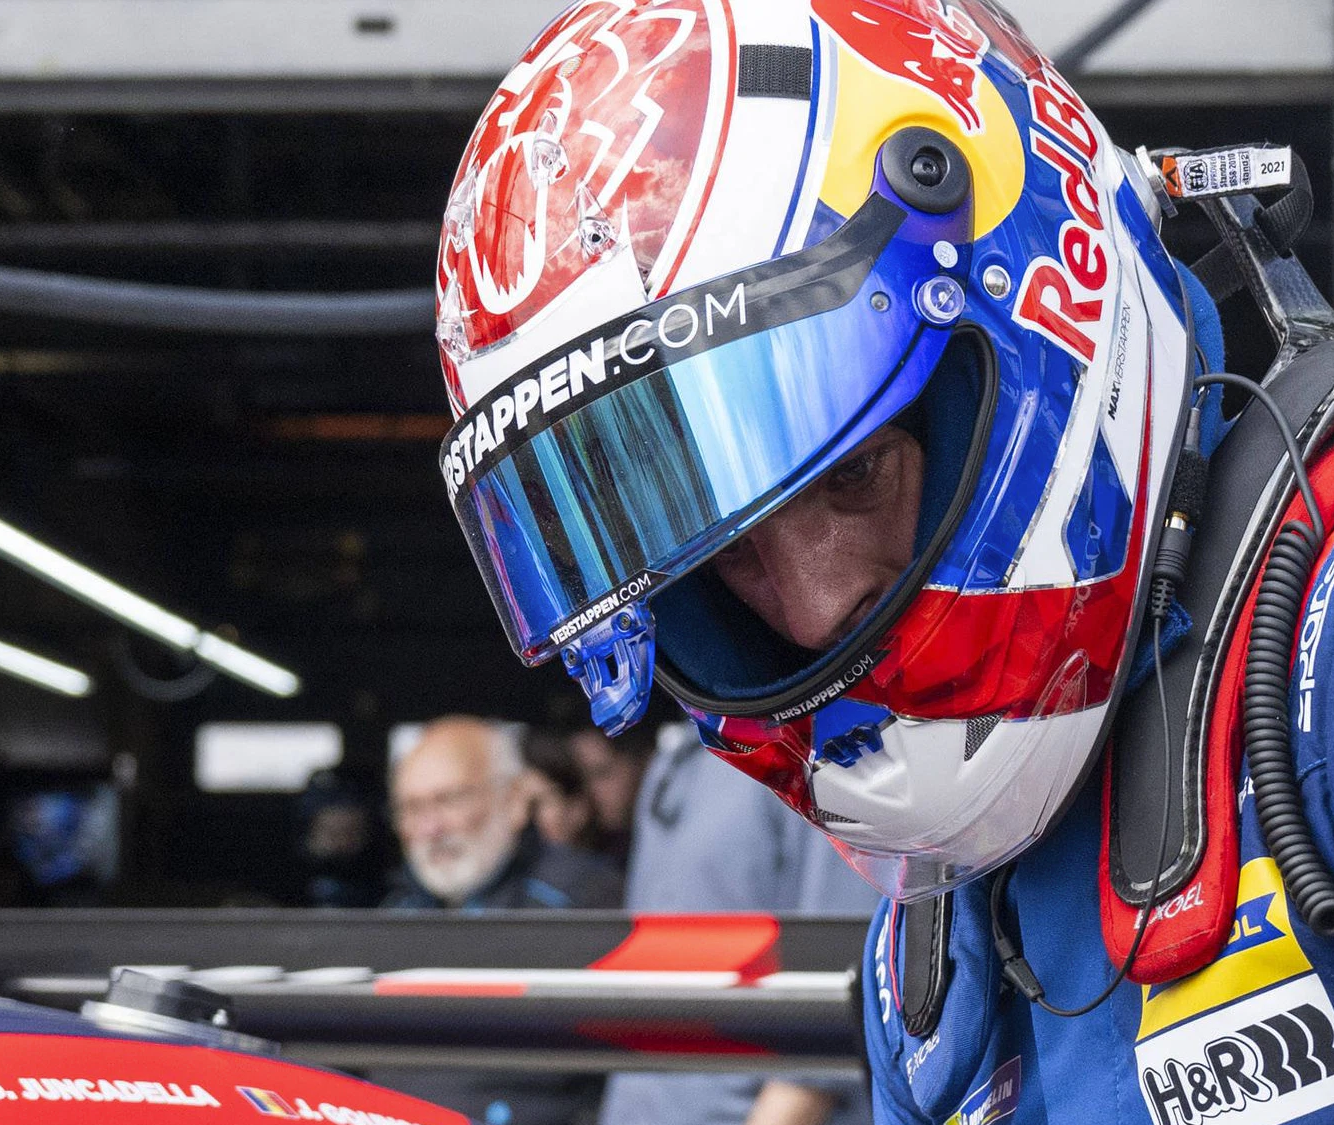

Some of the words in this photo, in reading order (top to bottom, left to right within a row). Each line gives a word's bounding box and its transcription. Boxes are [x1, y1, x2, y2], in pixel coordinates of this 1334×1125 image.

[1187, 162, 1205, 190] FIA
[1219, 154, 1228, 188] Standard
[1260, 160, 1286, 175] 2021
[550, 573, 652, 646] VERSTAPPEN.COM
[770, 654, 875, 723] VERSTAPPEN.COM
[17, 1077, 222, 1108] JUNCADELLA
